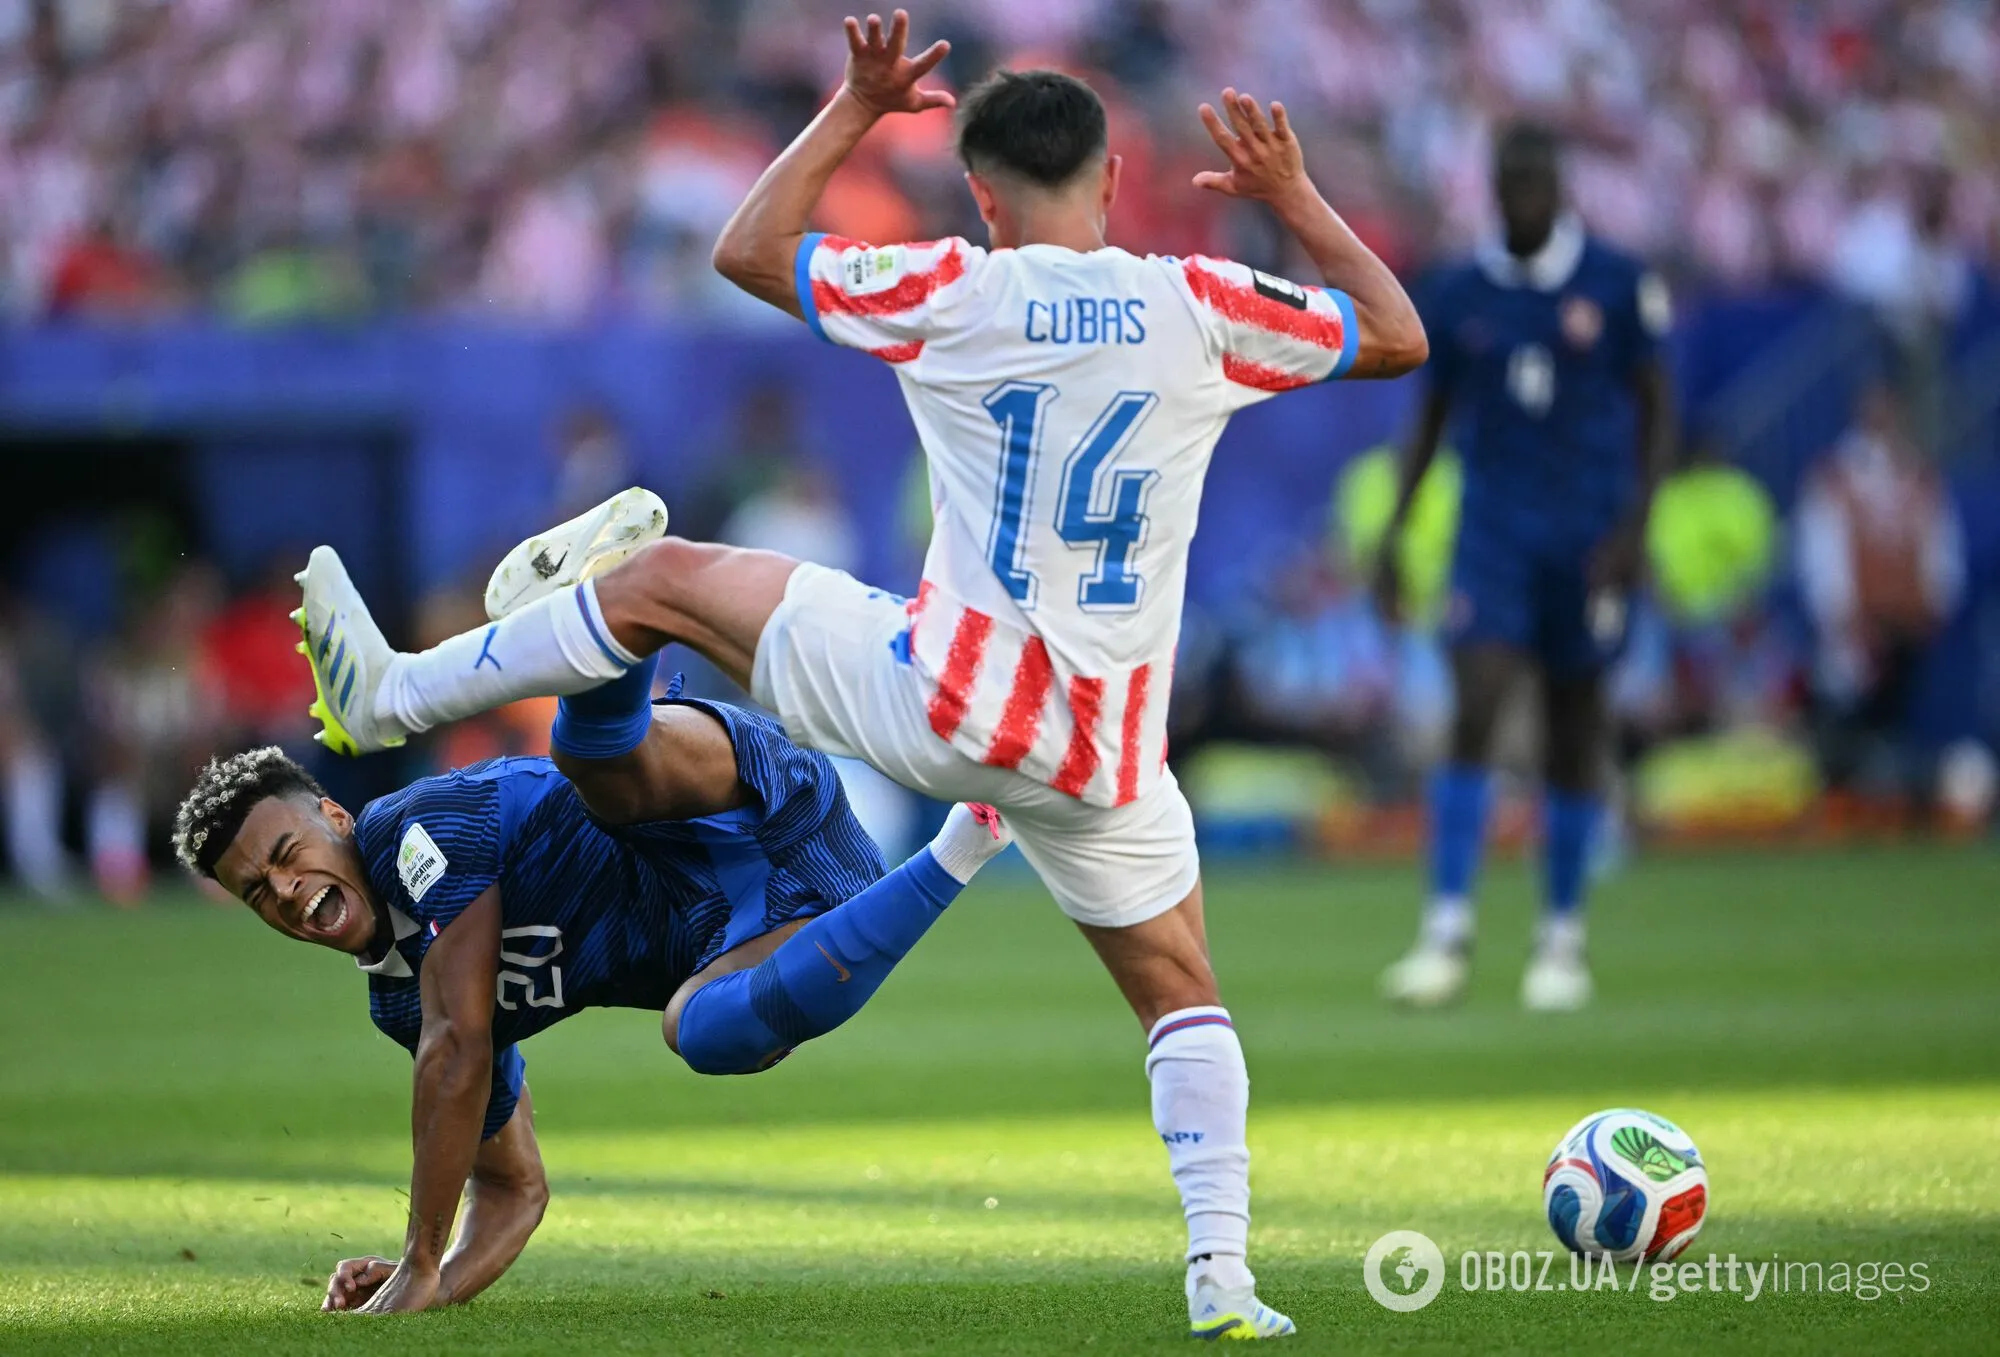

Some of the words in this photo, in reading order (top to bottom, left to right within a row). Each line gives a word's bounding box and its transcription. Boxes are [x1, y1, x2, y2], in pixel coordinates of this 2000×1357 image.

[1025, 298, 1146, 344] CUBAS
[981, 380, 1162, 613] 14
[419, 873, 431, 885] FIFA
[496, 925, 565, 1010] 20
